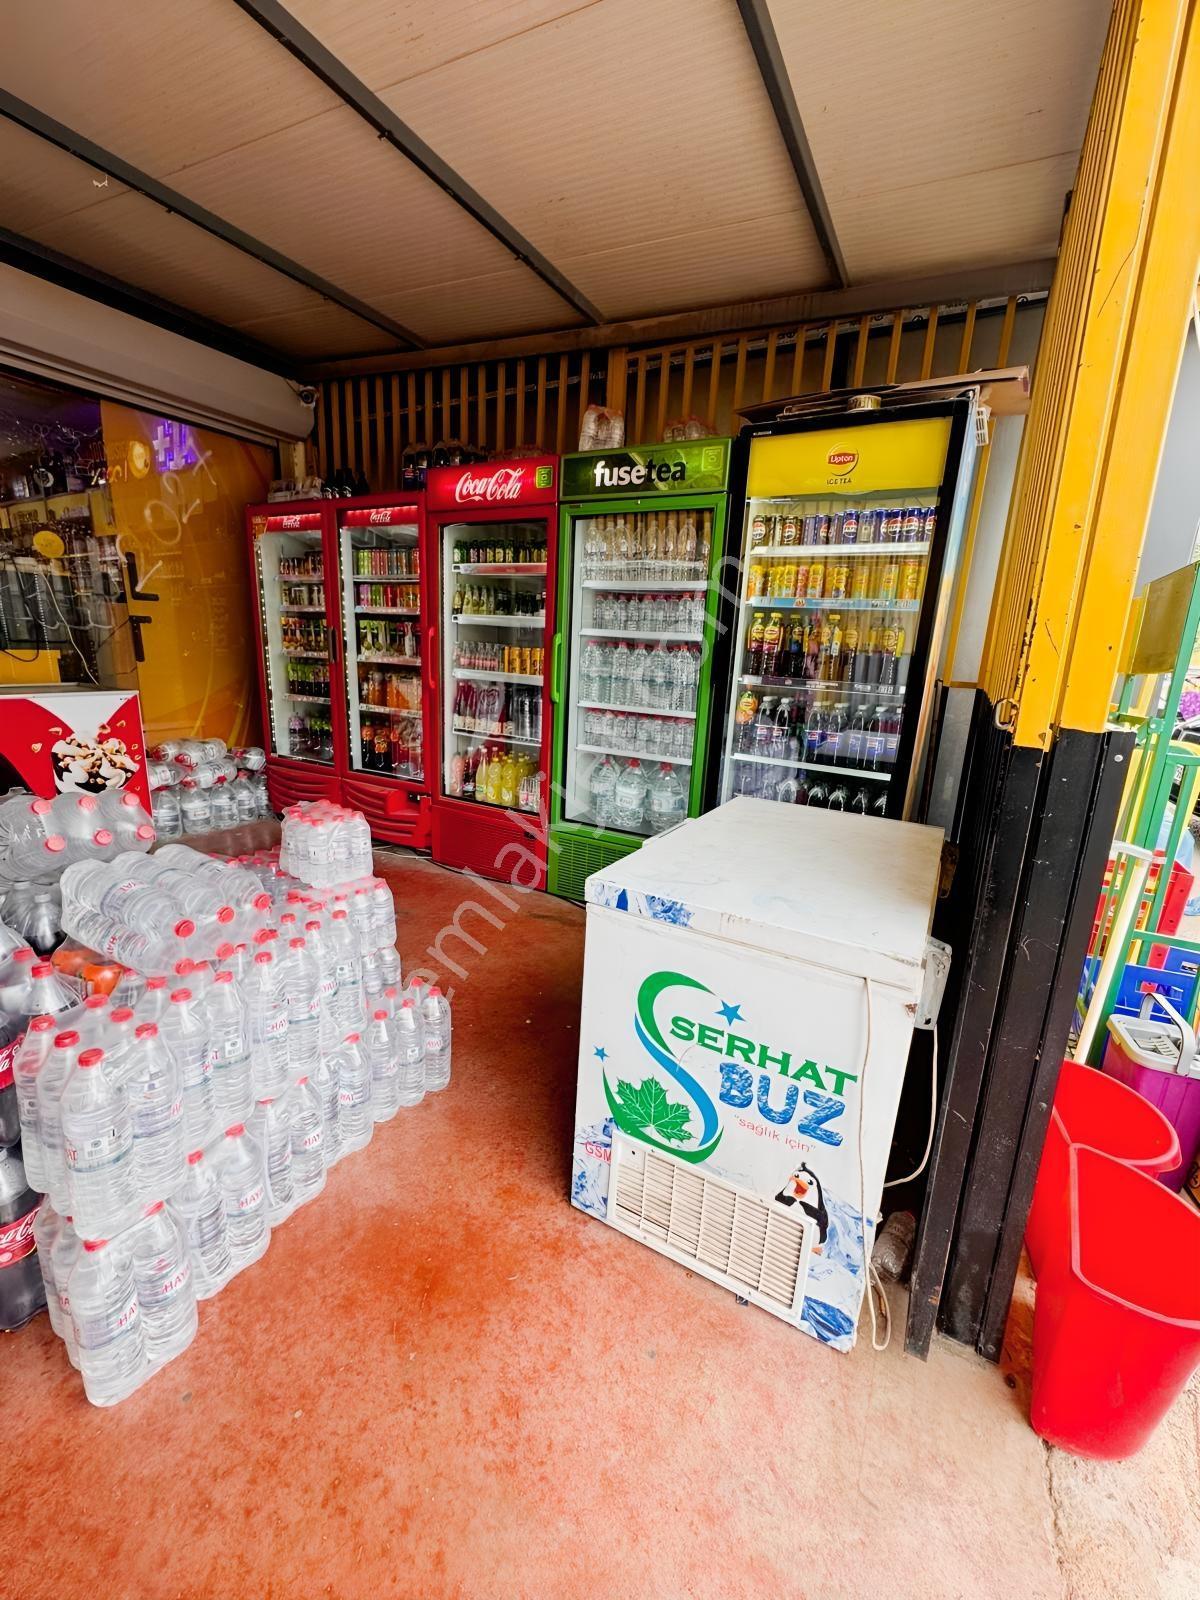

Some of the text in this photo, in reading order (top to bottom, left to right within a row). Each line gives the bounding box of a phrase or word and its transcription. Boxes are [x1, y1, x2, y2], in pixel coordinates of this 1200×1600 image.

[829, 453, 855, 465] Lipton
[456, 468, 525, 503] Coca-Cola
[827, 476, 852, 485] ICE TEA
[669, 1015, 858, 1096] SERHAT
[718, 1062, 846, 1147] BUZ
